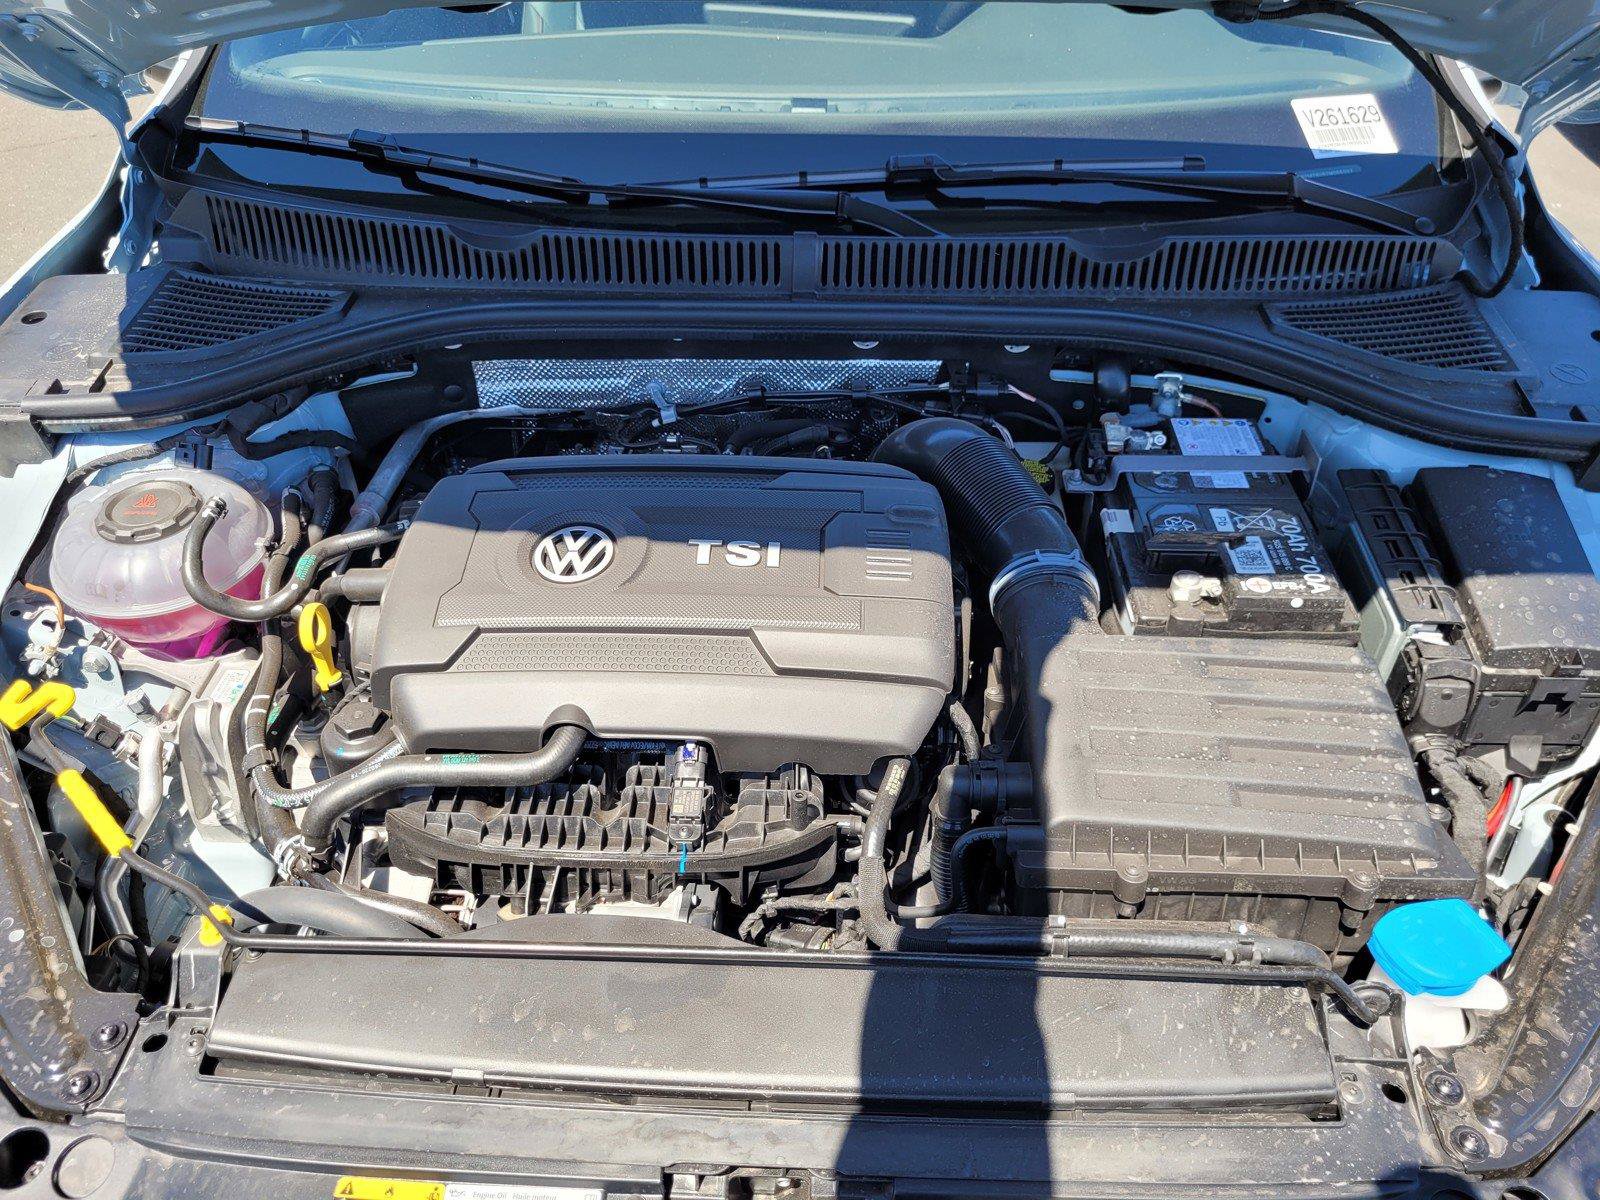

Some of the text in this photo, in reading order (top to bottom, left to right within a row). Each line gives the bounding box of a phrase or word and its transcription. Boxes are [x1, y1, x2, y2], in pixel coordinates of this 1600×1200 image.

[1302, 105, 1381, 127] V261629
[533, 525, 615, 583] VW
[688, 538, 781, 568] TSI
[1277, 517, 1309, 551] 70Ah
[1295, 556, 1331, 594] 700A
